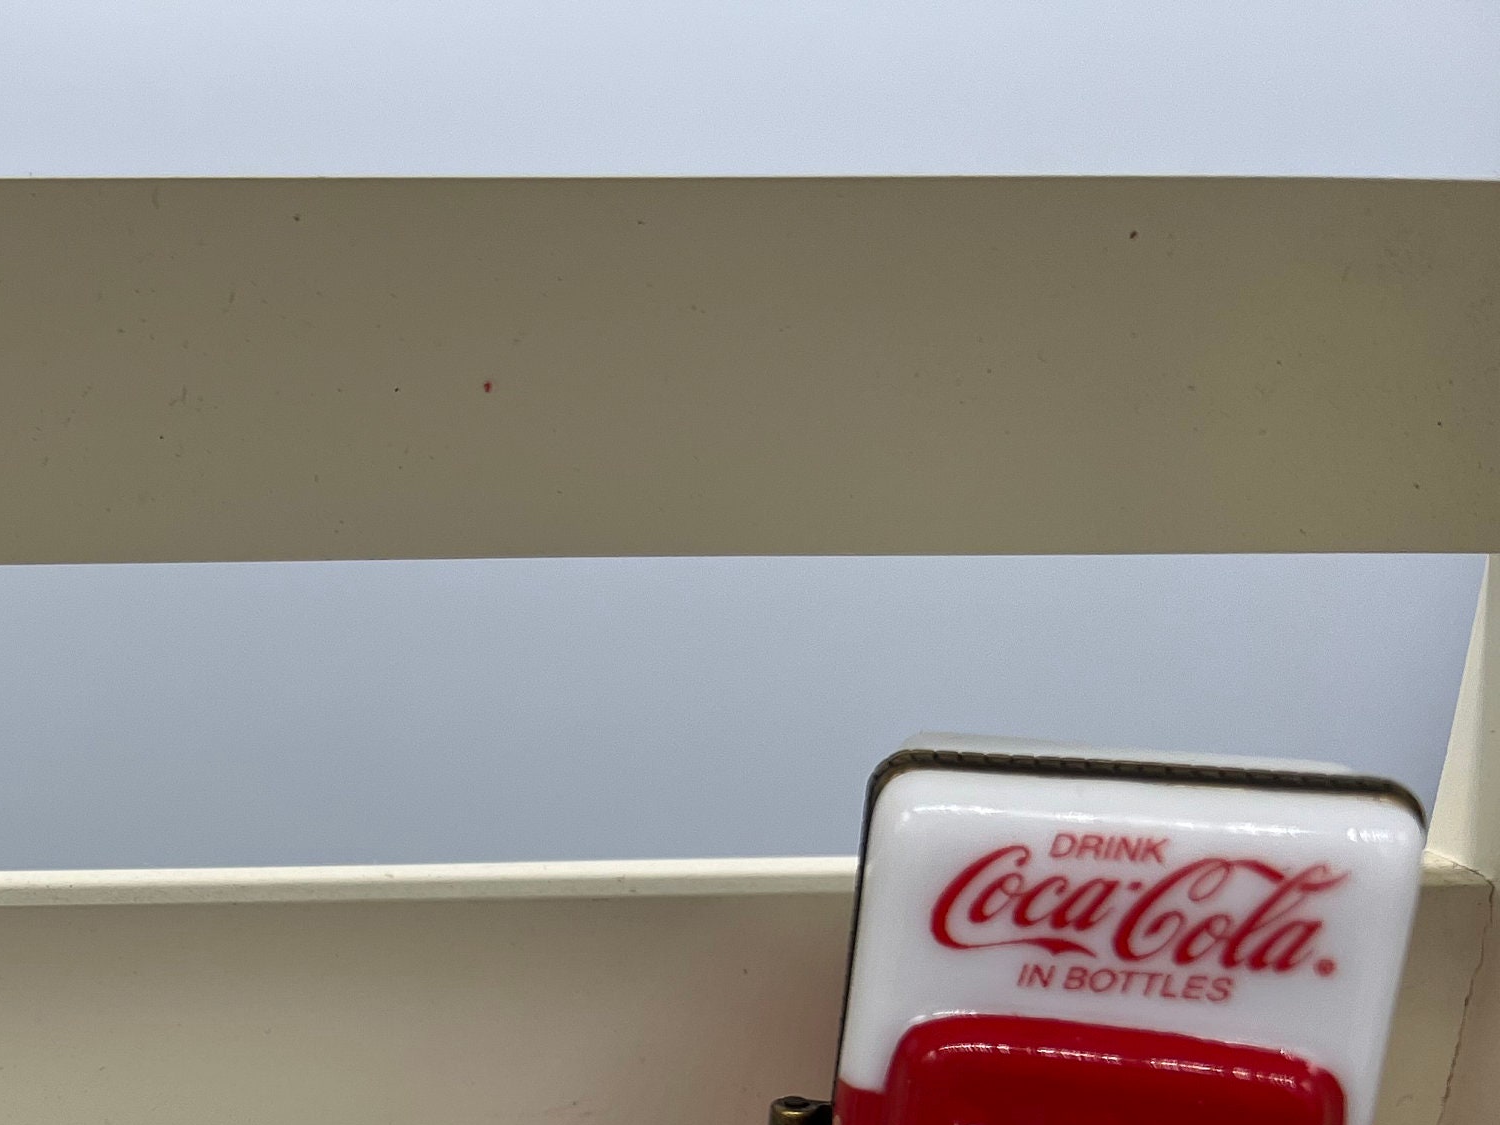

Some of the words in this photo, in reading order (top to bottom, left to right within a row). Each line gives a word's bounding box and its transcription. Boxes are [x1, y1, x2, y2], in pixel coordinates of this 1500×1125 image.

[1049, 831, 1172, 864] DRINK
[929, 845, 1353, 973] Coca-Cola
[1017, 963, 1056, 989] IN
[1063, 965, 1235, 1002] BOTTLES
